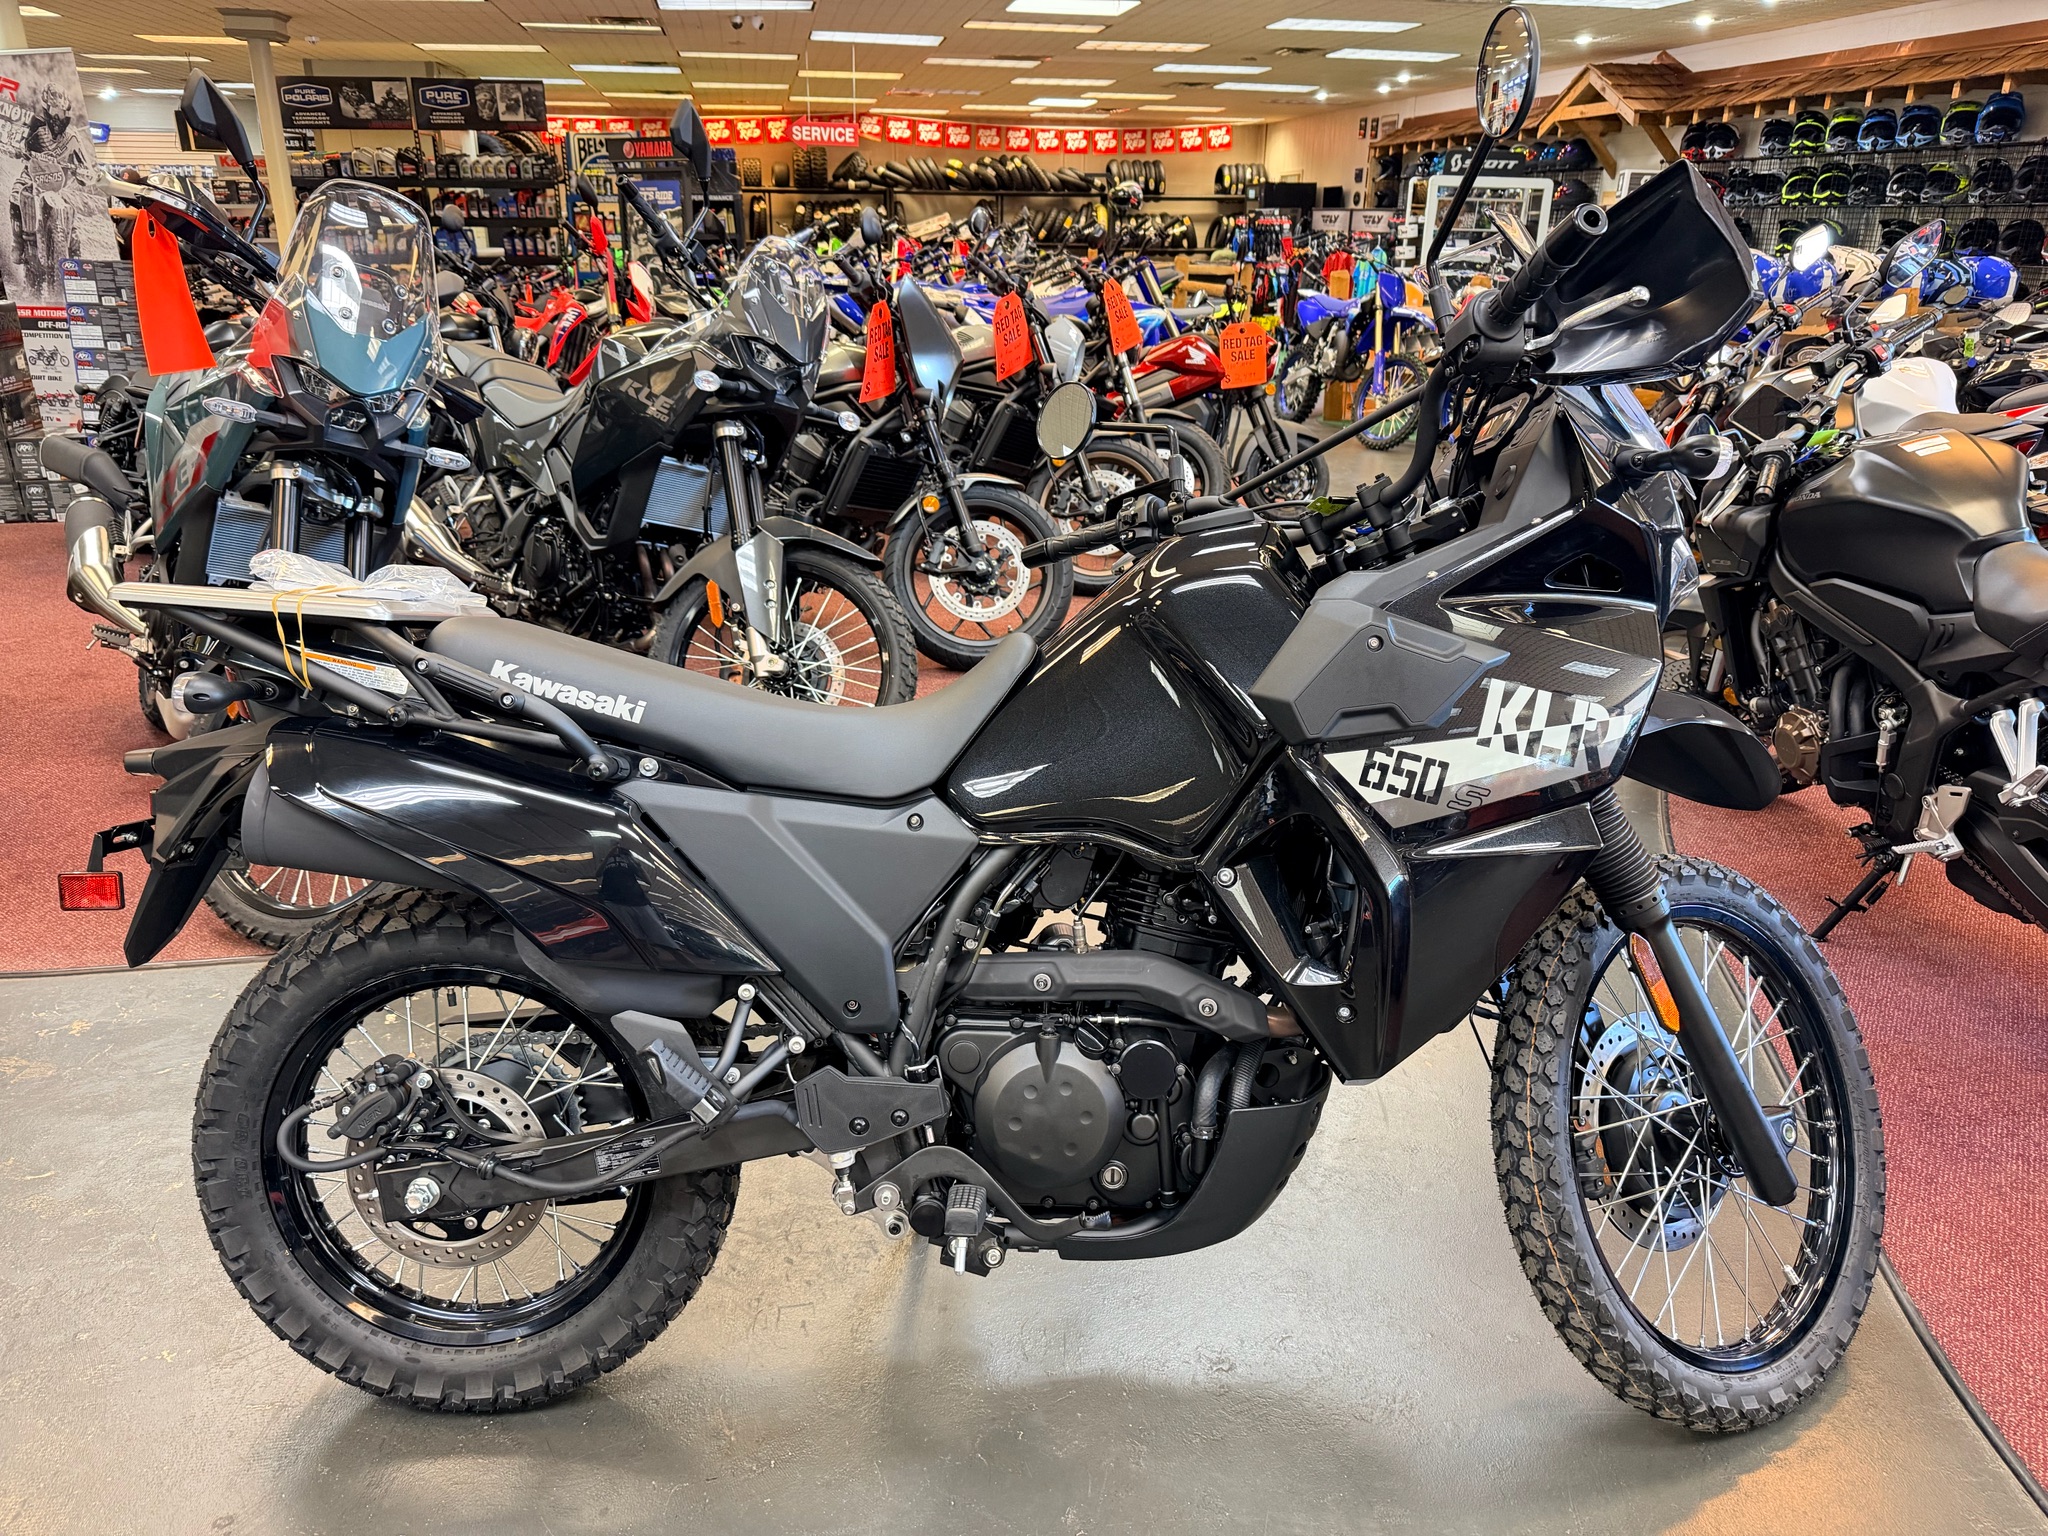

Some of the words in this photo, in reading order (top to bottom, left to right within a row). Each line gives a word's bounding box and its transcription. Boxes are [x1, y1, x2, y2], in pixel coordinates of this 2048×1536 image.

[284, 93, 330, 102] POLARIS
[425, 90, 463, 100] PURE
[739, 128, 762, 141] RED
[792, 125, 856, 143] SERVICE
[889, 128, 912, 140] RED
[920, 131, 941, 143] RED
[949, 134, 971, 146] RED
[979, 136, 1001, 148] RED
[1008, 137, 1030, 150] RED
[1038, 138, 1059, 151] RED
[1066, 139, 1088, 152] RED
[1096, 139, 1117, 152] RED
[1125, 139, 1146, 151] RED
[1154, 138, 1174, 150] RED
[1182, 136, 1203, 150] RED
[1210, 135, 1231, 148] RED
[633, 140, 674, 158] YAMAHA
[1107, 296, 1119, 310] RED
[33, 310, 67, 319] MOTORS
[996, 318, 1011, 336] RED
[1010, 304, 1023, 324] TAG
[1114, 308, 1129, 323] SALE
[869, 327, 883, 346] RED
[882, 319, 892, 340] TAG
[1003, 324, 1022, 348] SALE
[1223, 338, 1242, 350] RED
[1244, 335, 1263, 347] TAG
[873, 341, 890, 363] SALE
[1230, 349, 1256, 362] SALE
[1000, 362, 1006, 375] $
[1225, 374, 1232, 384] $
[864, 381, 871, 396] $
[619, 377, 675, 415] KLE
[645, 407, 670, 423] 500
[332, 658, 357, 668] WARNING
[490, 659, 648, 725] Kawasaki
[1476, 677, 1613, 772] KLR
[1358, 745, 1451, 806] 650
[1446, 783, 1492, 812] S
